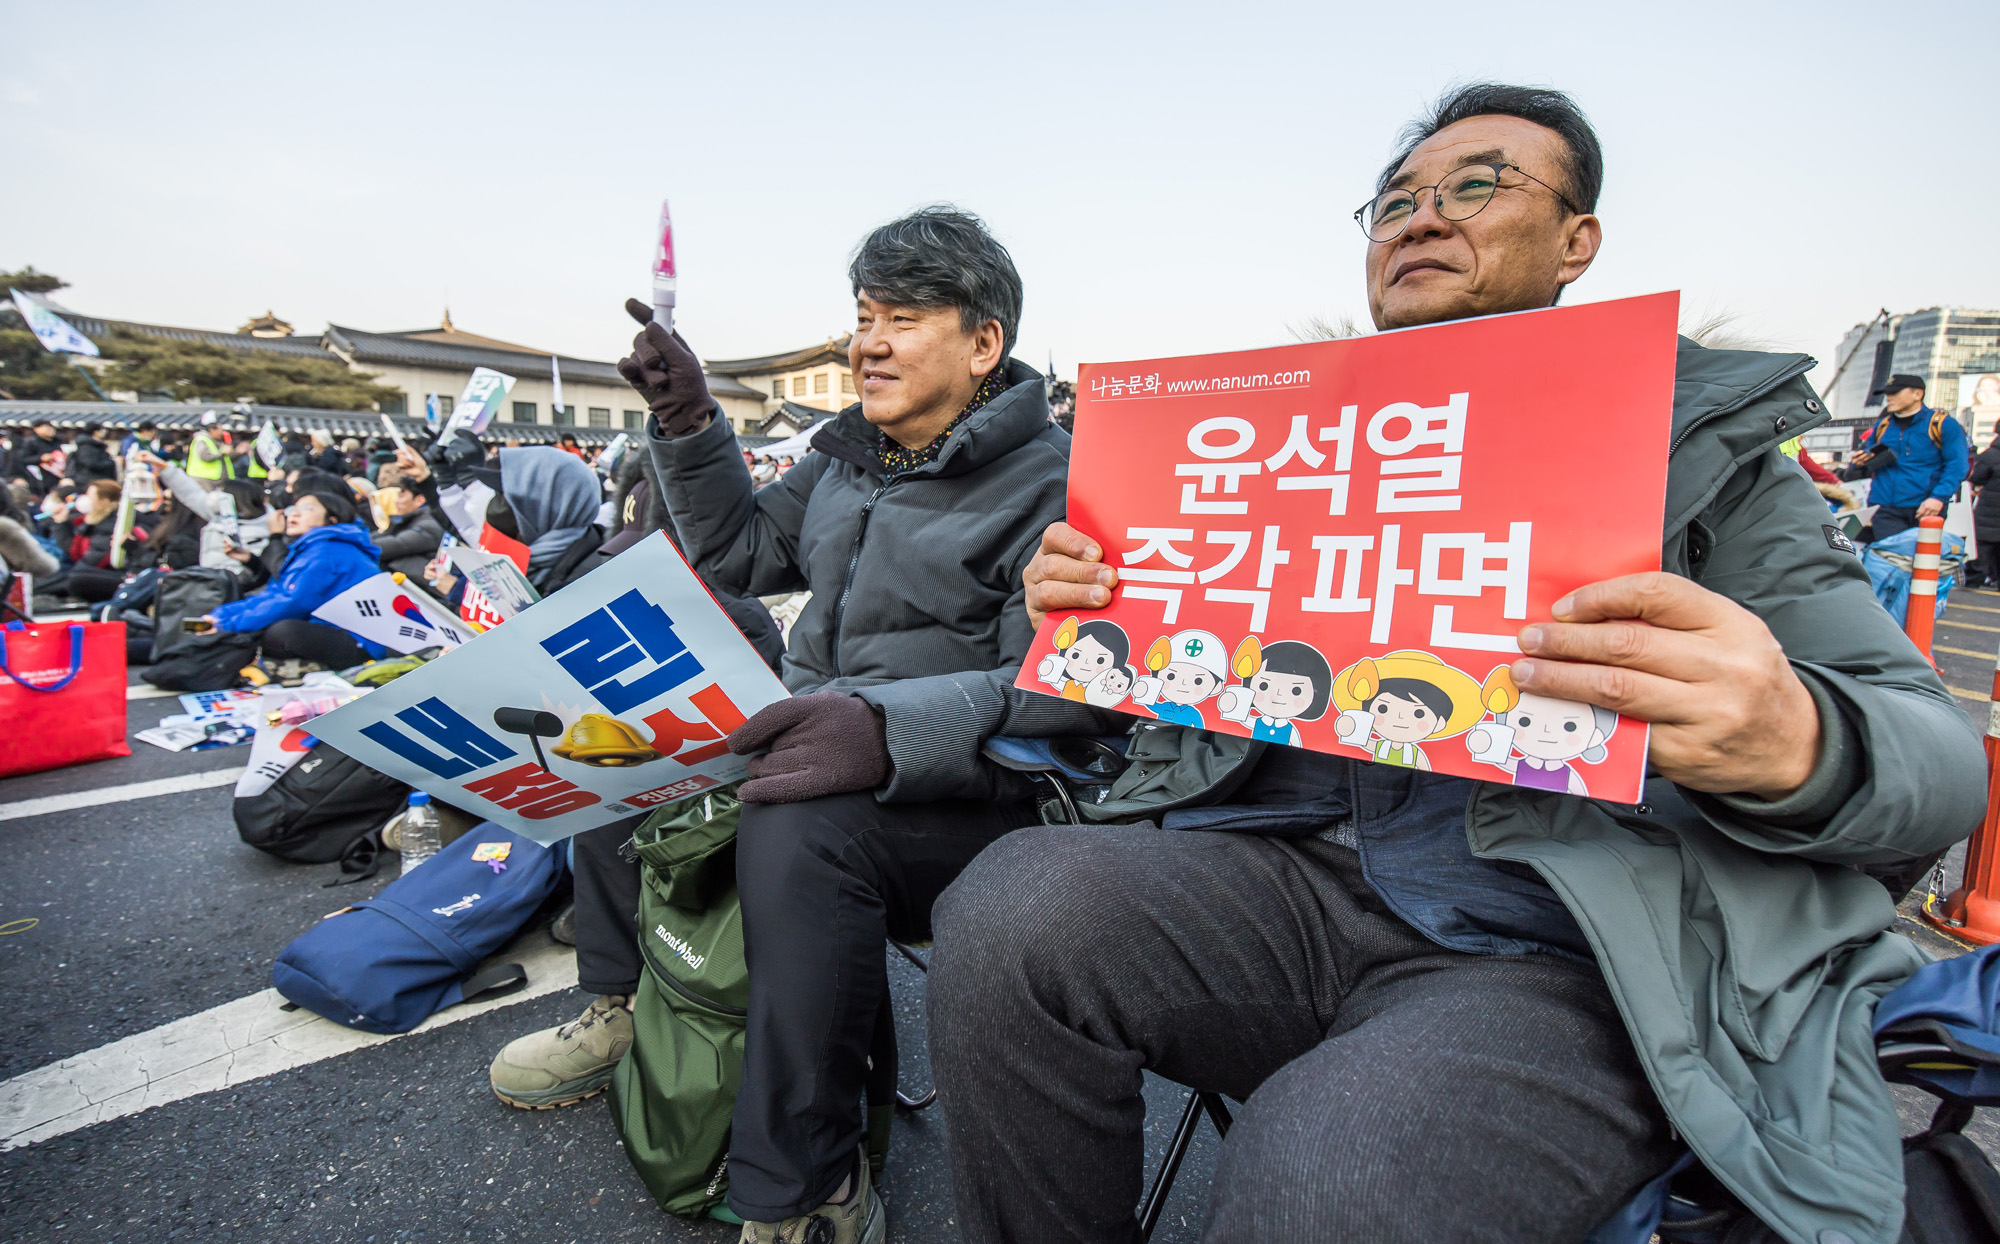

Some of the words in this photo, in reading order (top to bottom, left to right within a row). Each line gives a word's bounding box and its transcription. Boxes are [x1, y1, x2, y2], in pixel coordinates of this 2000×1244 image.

[1091, 373, 1162, 397] 나눔문화
[1167, 369, 1310, 393] www.nanum.com
[1174, 392, 1469, 515] 윤석열
[1117, 525, 1290, 634] 즉각
[1301, 521, 1532, 653] 파면
[635, 778, 702, 804] 진보당
